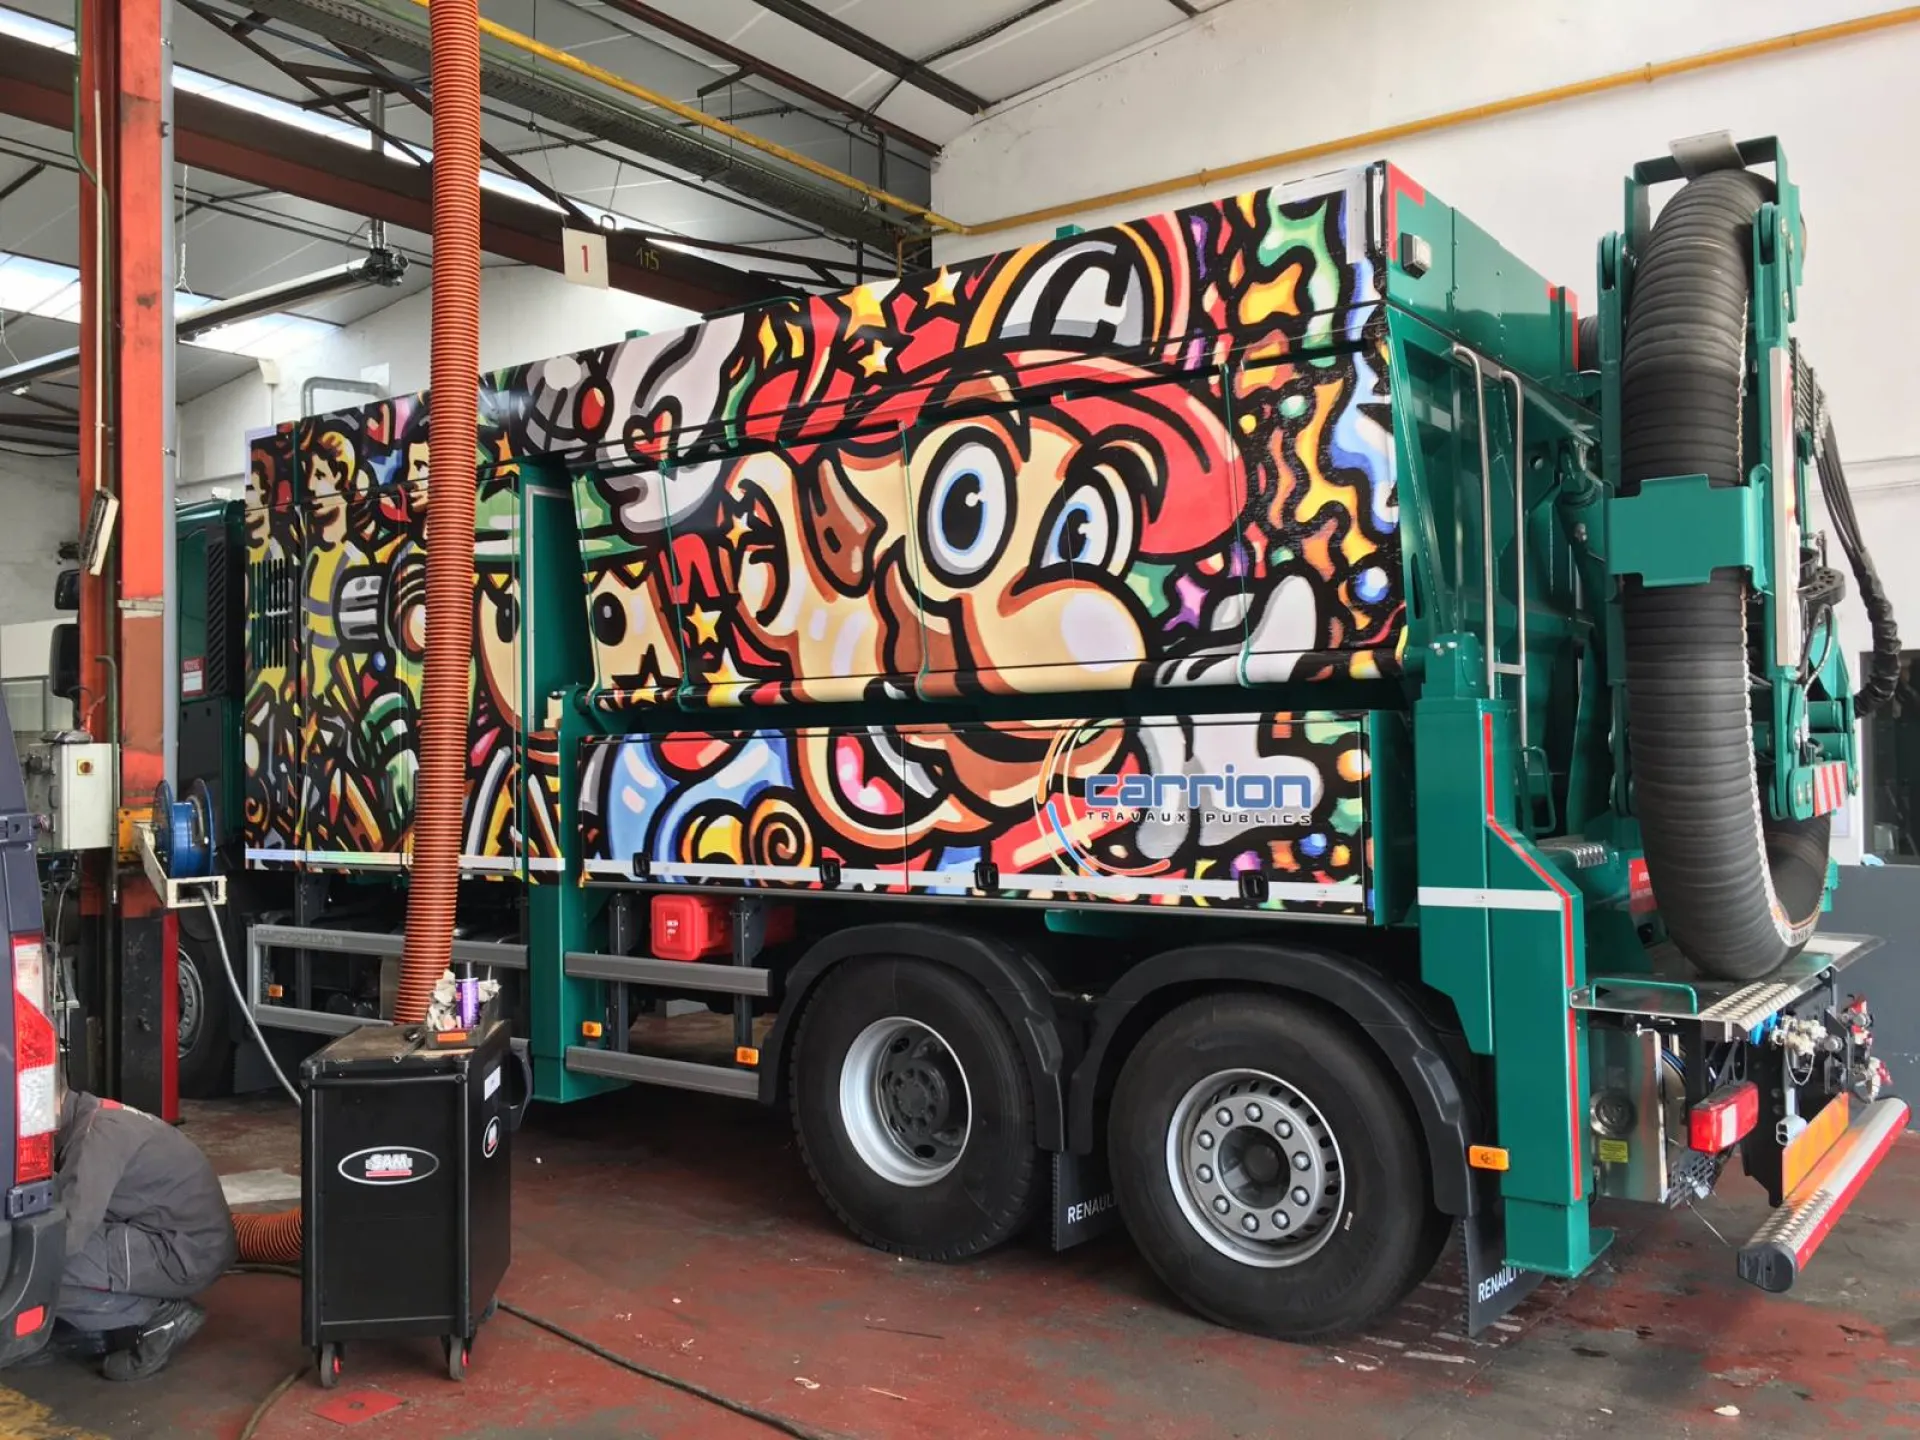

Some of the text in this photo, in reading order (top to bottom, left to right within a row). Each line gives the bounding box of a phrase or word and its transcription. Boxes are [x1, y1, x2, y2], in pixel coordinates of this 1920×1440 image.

[581, 245, 589, 273] 1
[1085, 764, 1311, 808] carrion
[1087, 811, 1312, 825] TRAVAUX PUBLICS
